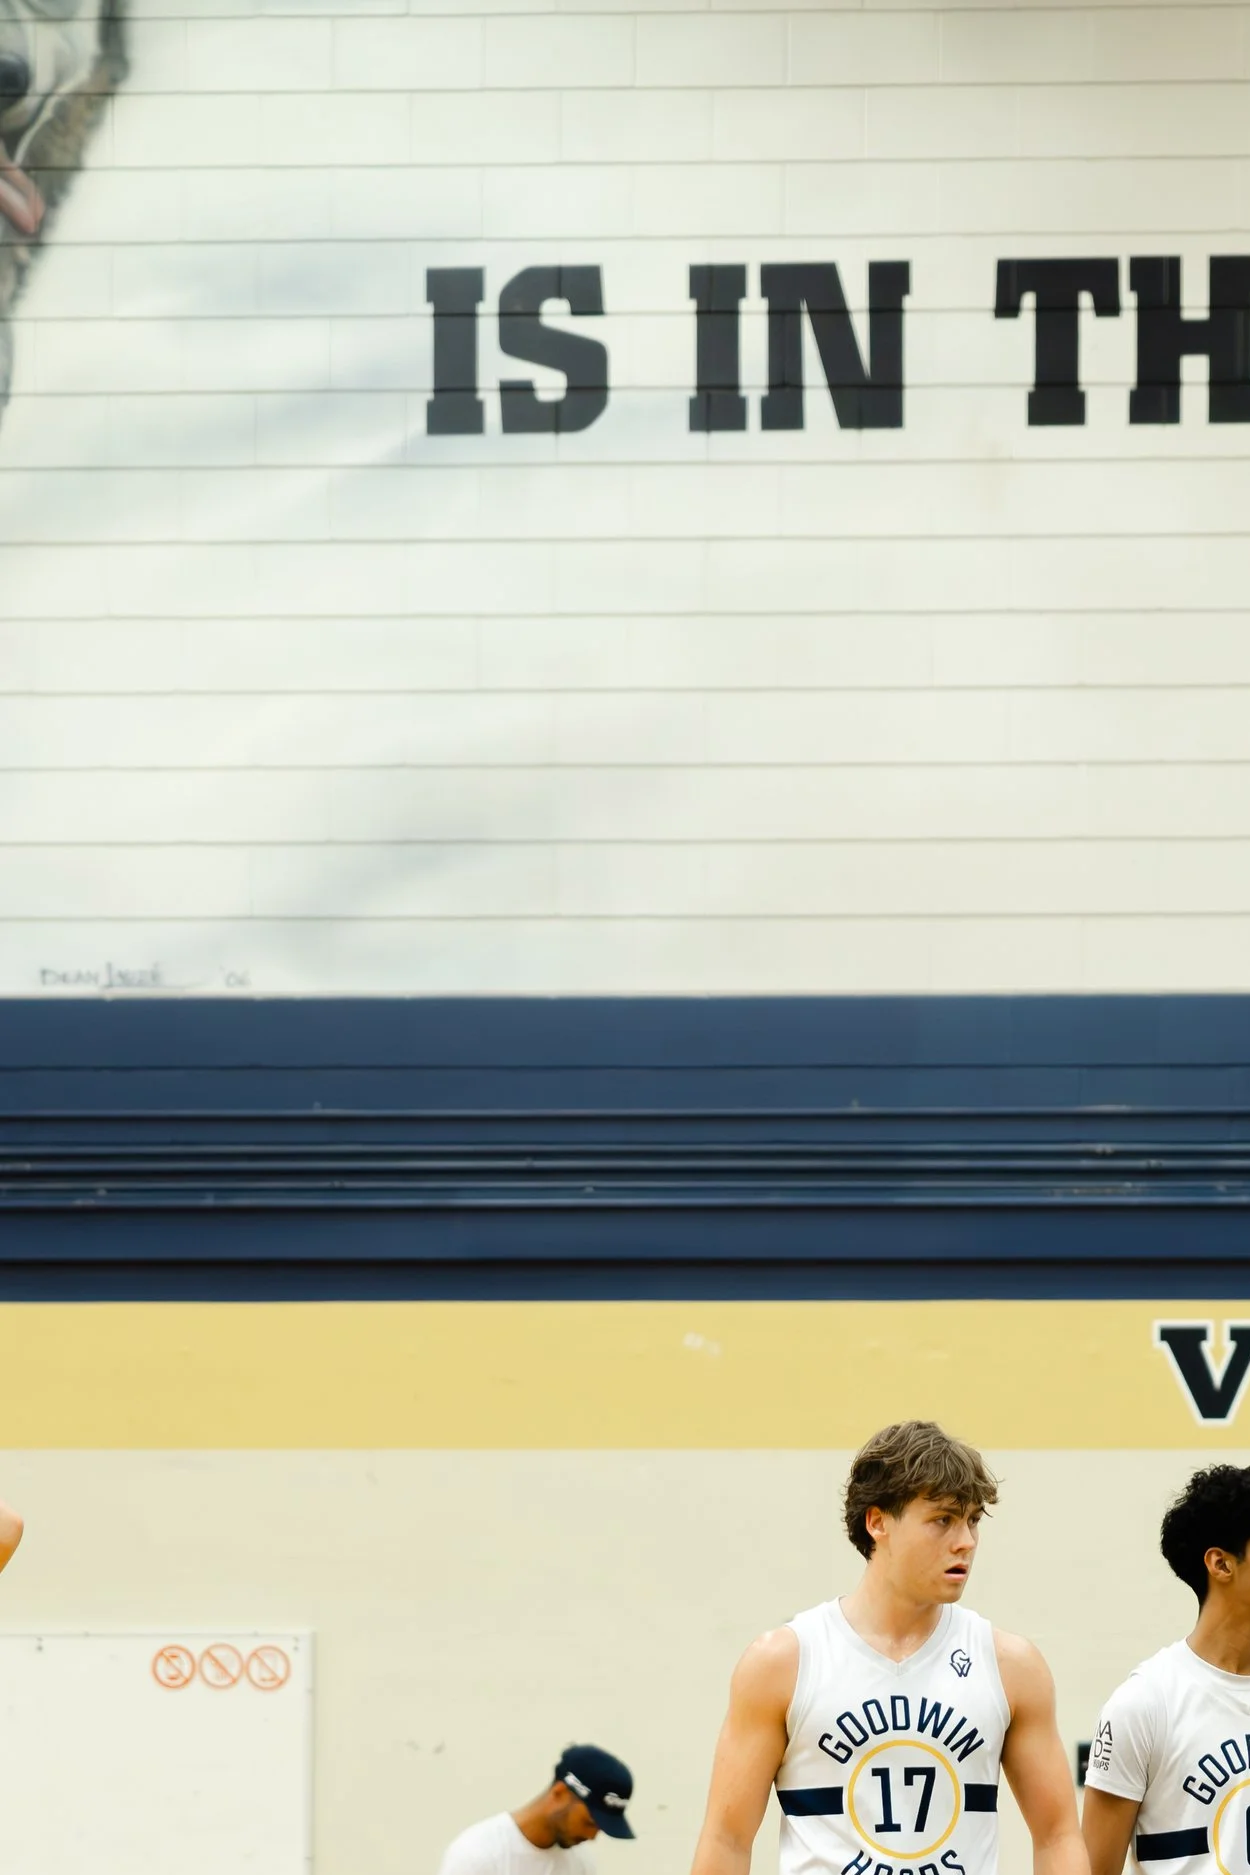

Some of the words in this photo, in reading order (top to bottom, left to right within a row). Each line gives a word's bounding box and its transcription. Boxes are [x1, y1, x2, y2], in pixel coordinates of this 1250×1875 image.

[425, 264, 608, 435] IS
[688, 260, 911, 432] IN
[817, 1695, 985, 1764] GOODWIN
[871, 1767, 937, 1833] 17
